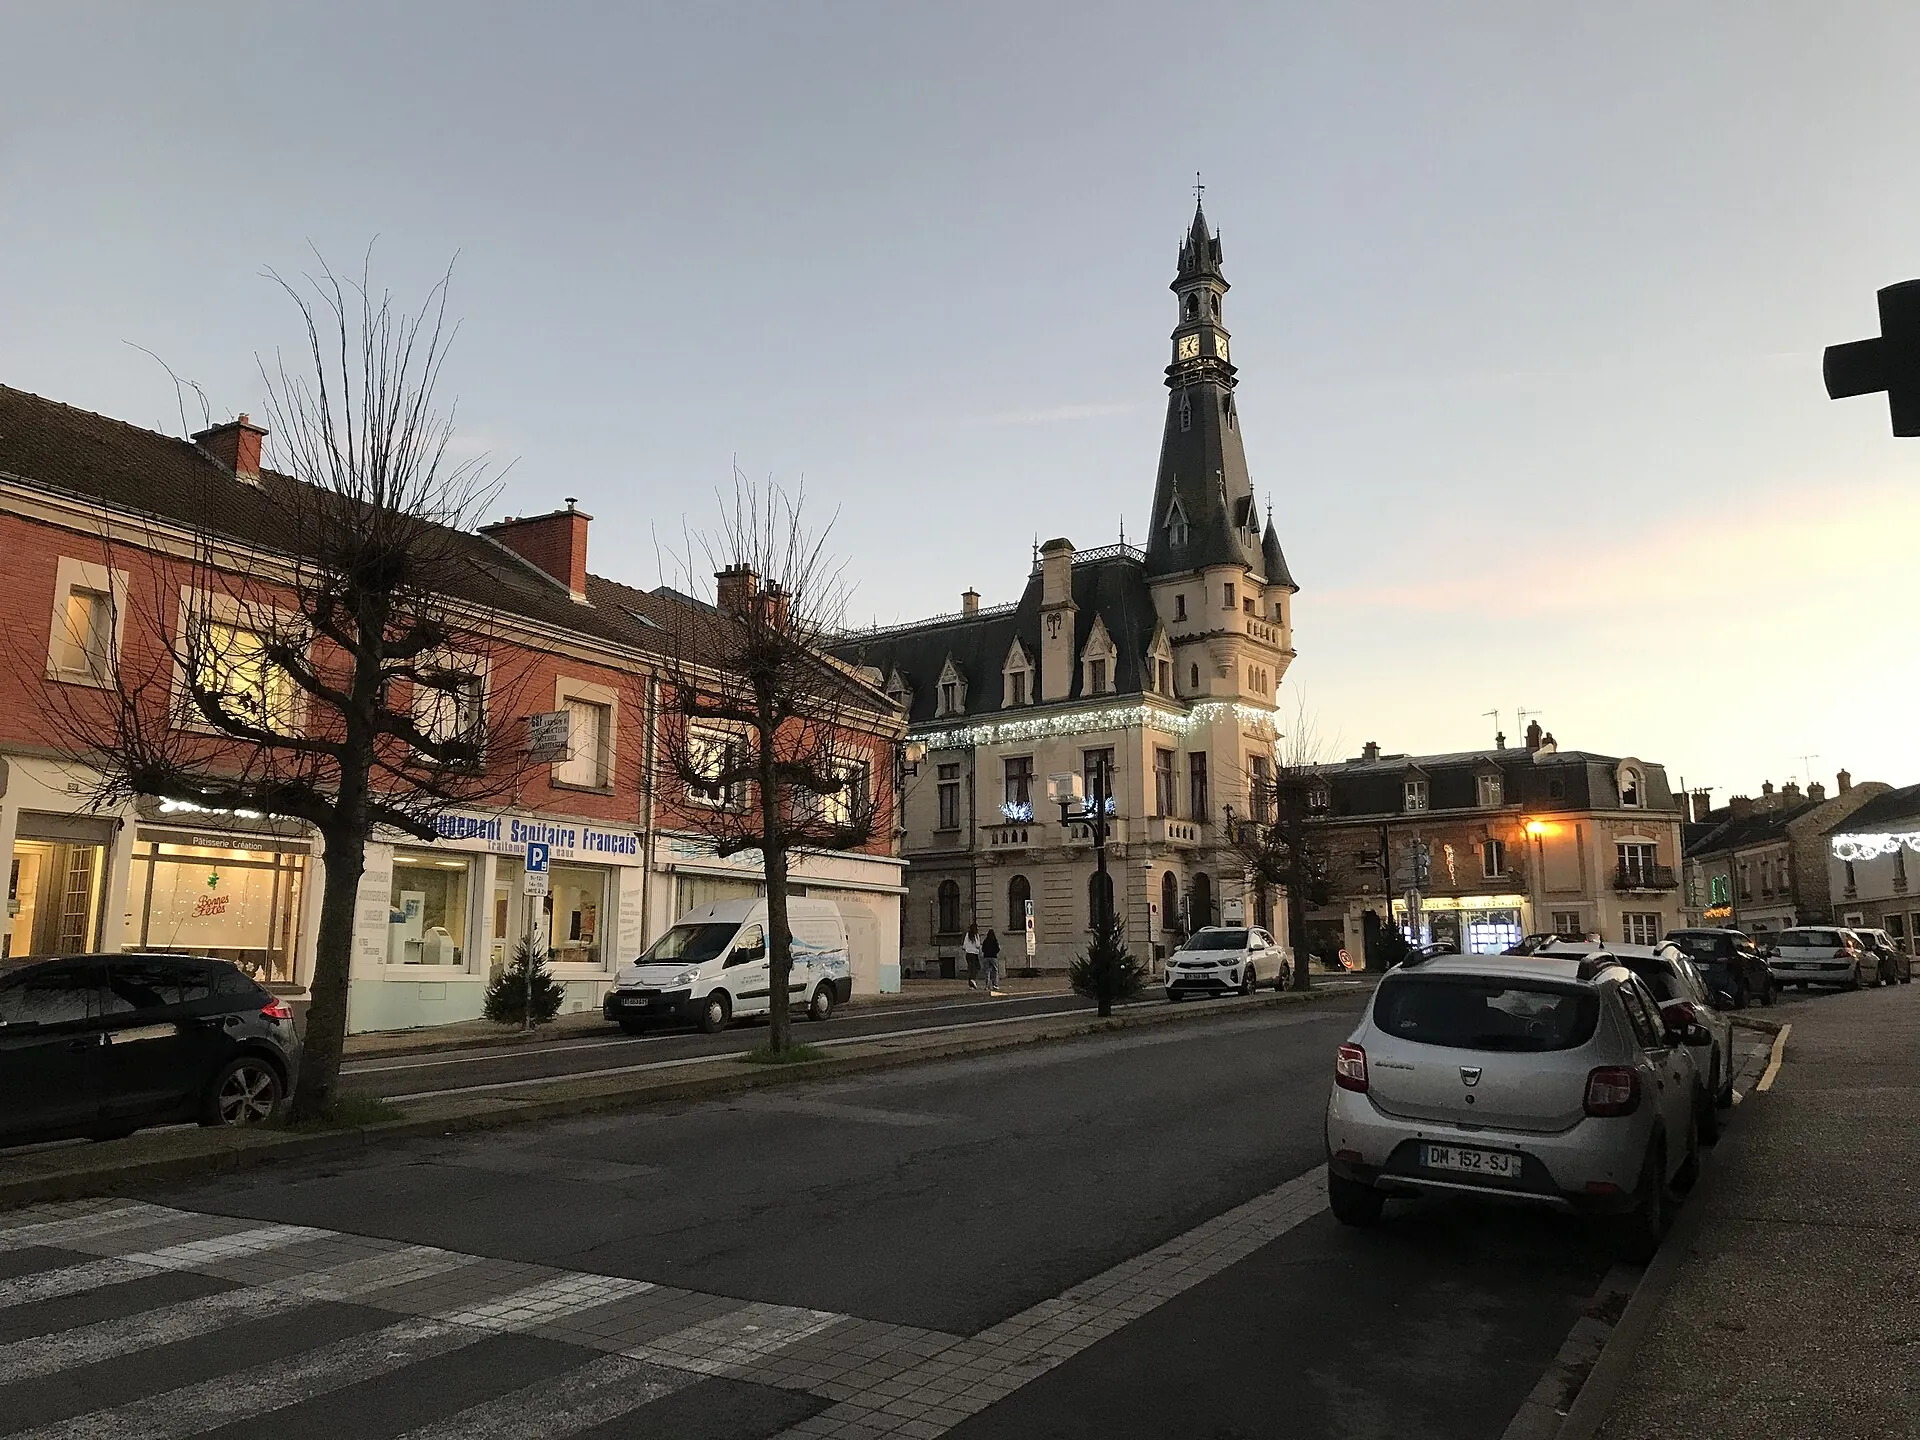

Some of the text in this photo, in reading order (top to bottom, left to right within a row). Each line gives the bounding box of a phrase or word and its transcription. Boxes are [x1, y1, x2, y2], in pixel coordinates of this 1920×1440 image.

[192, 836, 263, 851] Pâtisserie Création
[511, 820, 575, 848] Sanitaire
[583, 828, 637, 856] Français
[488, 841, 525, 853] Traiteme
[532, 847, 543, 867] P
[198, 895, 230, 907] Bonnes
[191, 904, 226, 918] Fêtes
[1431, 1148, 1509, 1172] DM-152-SJ
